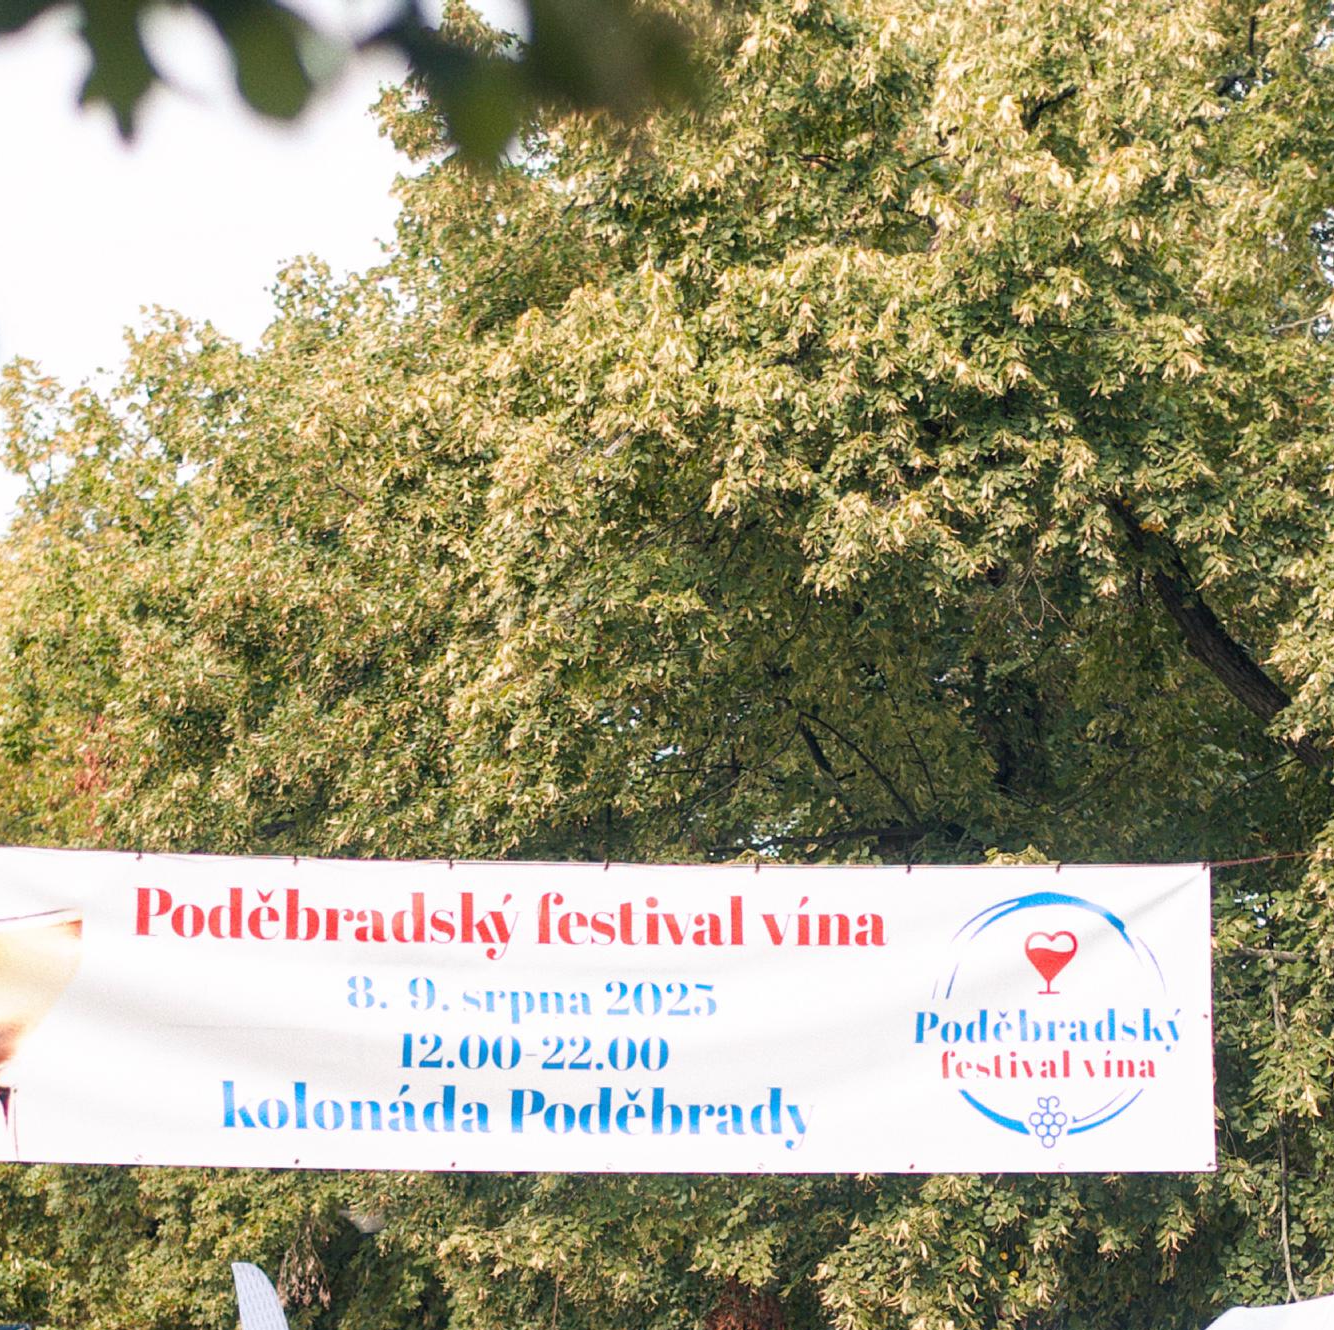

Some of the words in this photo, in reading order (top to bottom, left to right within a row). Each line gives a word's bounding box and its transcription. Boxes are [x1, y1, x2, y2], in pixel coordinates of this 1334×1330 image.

[132, 887, 521, 961] Poděbradský
[535, 891, 748, 946] festival
[761, 895, 890, 947] vína
[347, 975, 388, 1010] 8.
[408, 976, 451, 1012] 9.
[462, 989, 592, 1024] srpna
[605, 980, 718, 1016] 2025
[914, 1007, 1183, 1054] Poděbradský
[941, 1049, 1070, 1079] festival
[1083, 1049, 1157, 1079] vína
[220, 1080, 492, 1133] kolonáda
[509, 1086, 815, 1151] Poděbrady
